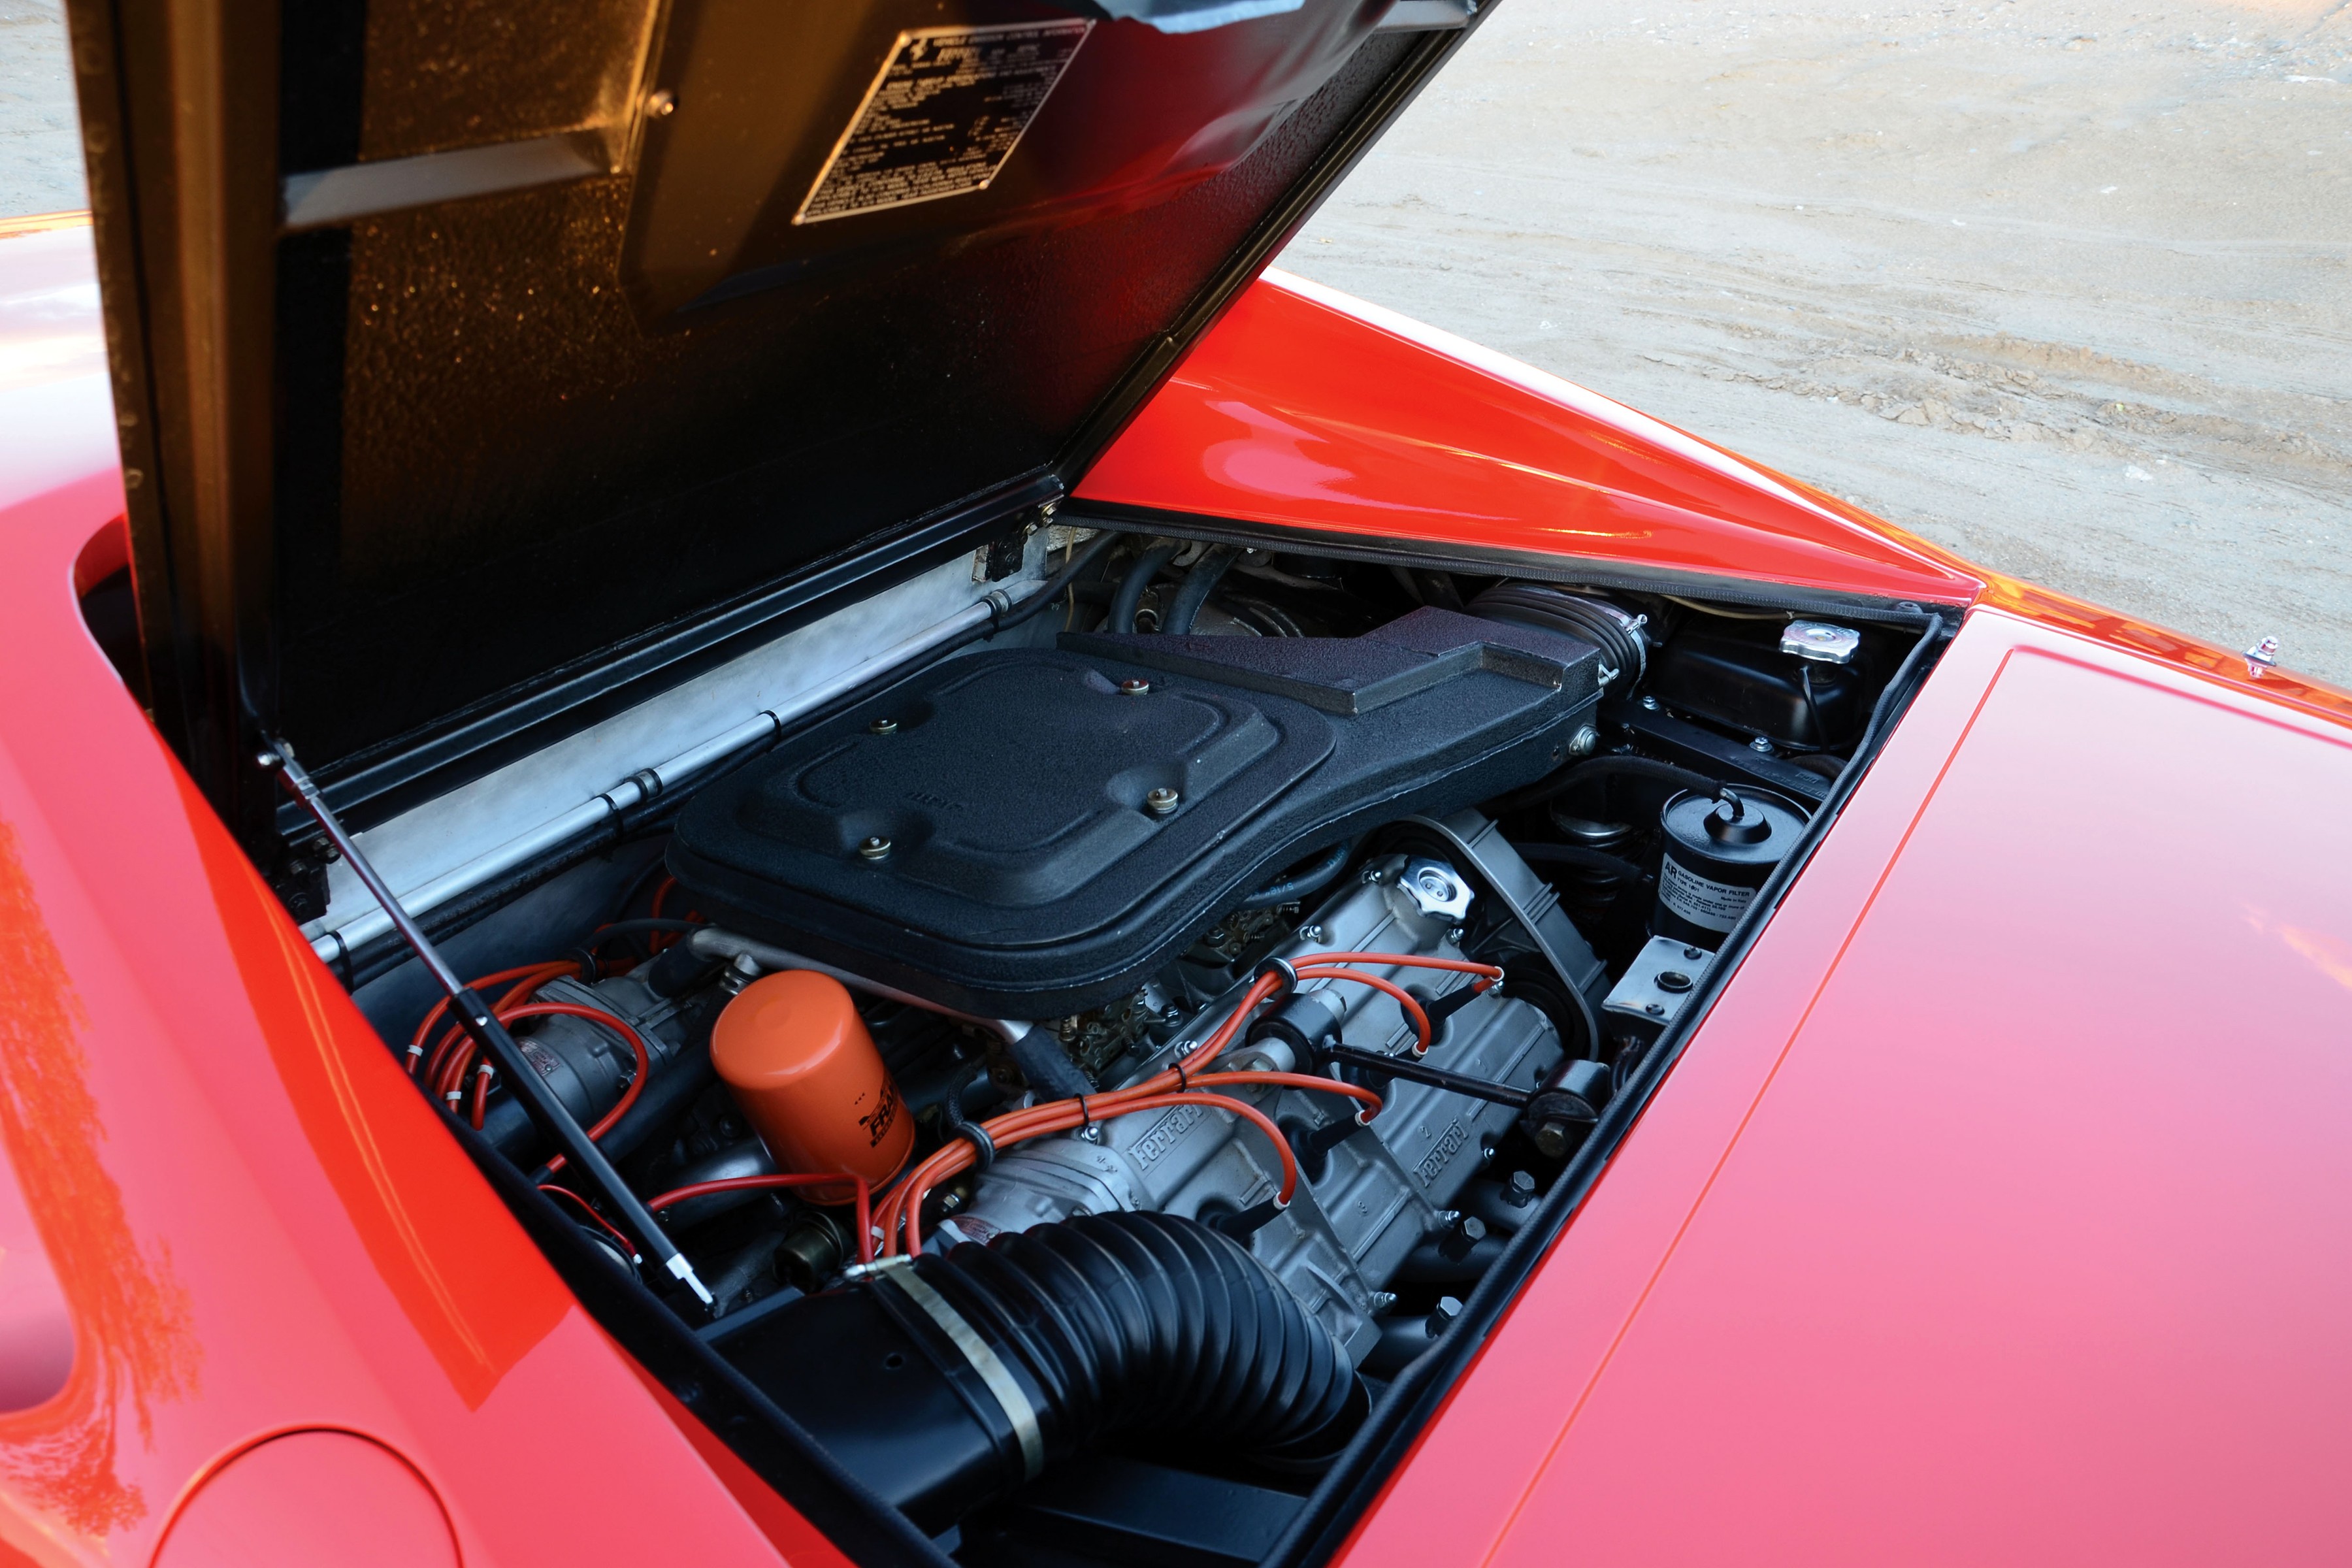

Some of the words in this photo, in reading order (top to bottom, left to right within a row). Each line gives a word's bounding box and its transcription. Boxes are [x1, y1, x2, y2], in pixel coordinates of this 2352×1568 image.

[1665, 862, 1677, 878] AR
[1678, 870, 1704, 887] GASOLINE
[1706, 884, 1726, 894] VAPOR
[1128, 1104, 1202, 1169] Ferrari
[1411, 1118, 1468, 1187] Ferrari
